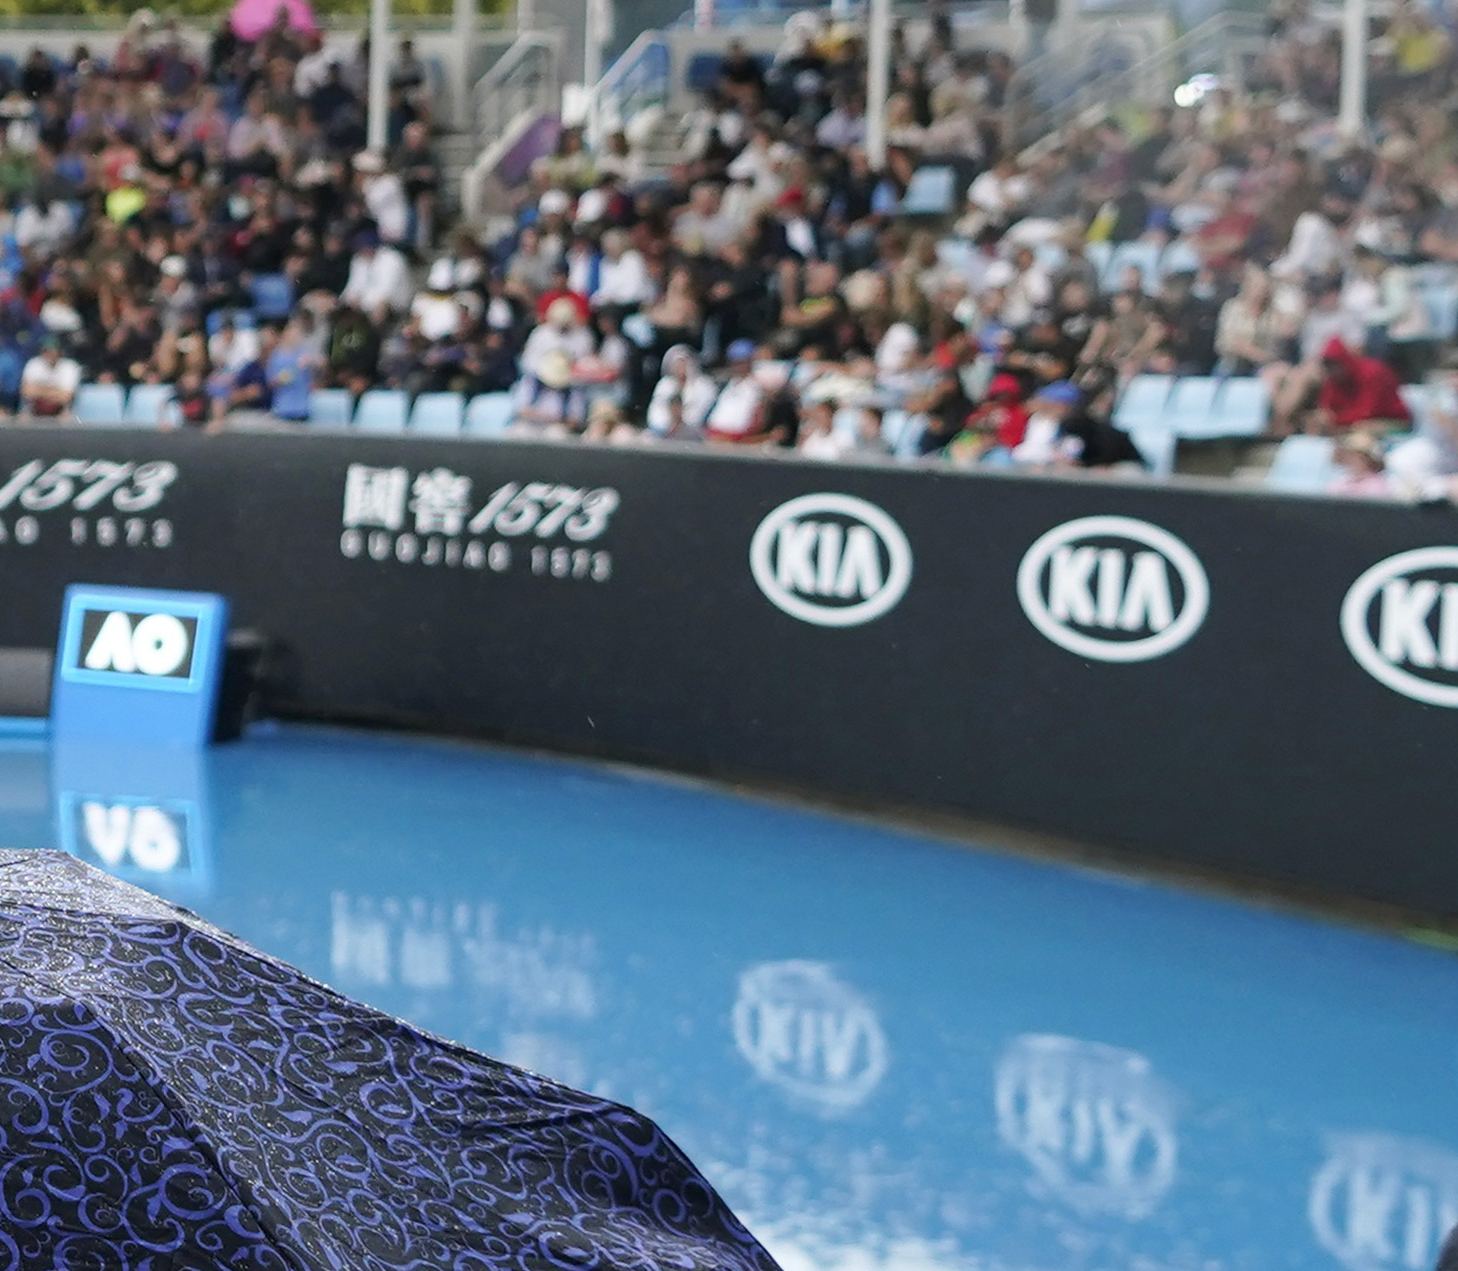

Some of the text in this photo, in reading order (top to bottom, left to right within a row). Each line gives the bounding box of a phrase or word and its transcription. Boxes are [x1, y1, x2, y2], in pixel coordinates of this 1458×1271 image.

[776, 520, 881, 600] KIA
[1048, 545, 1175, 633] KIA
[86, 612, 189, 676] AO
